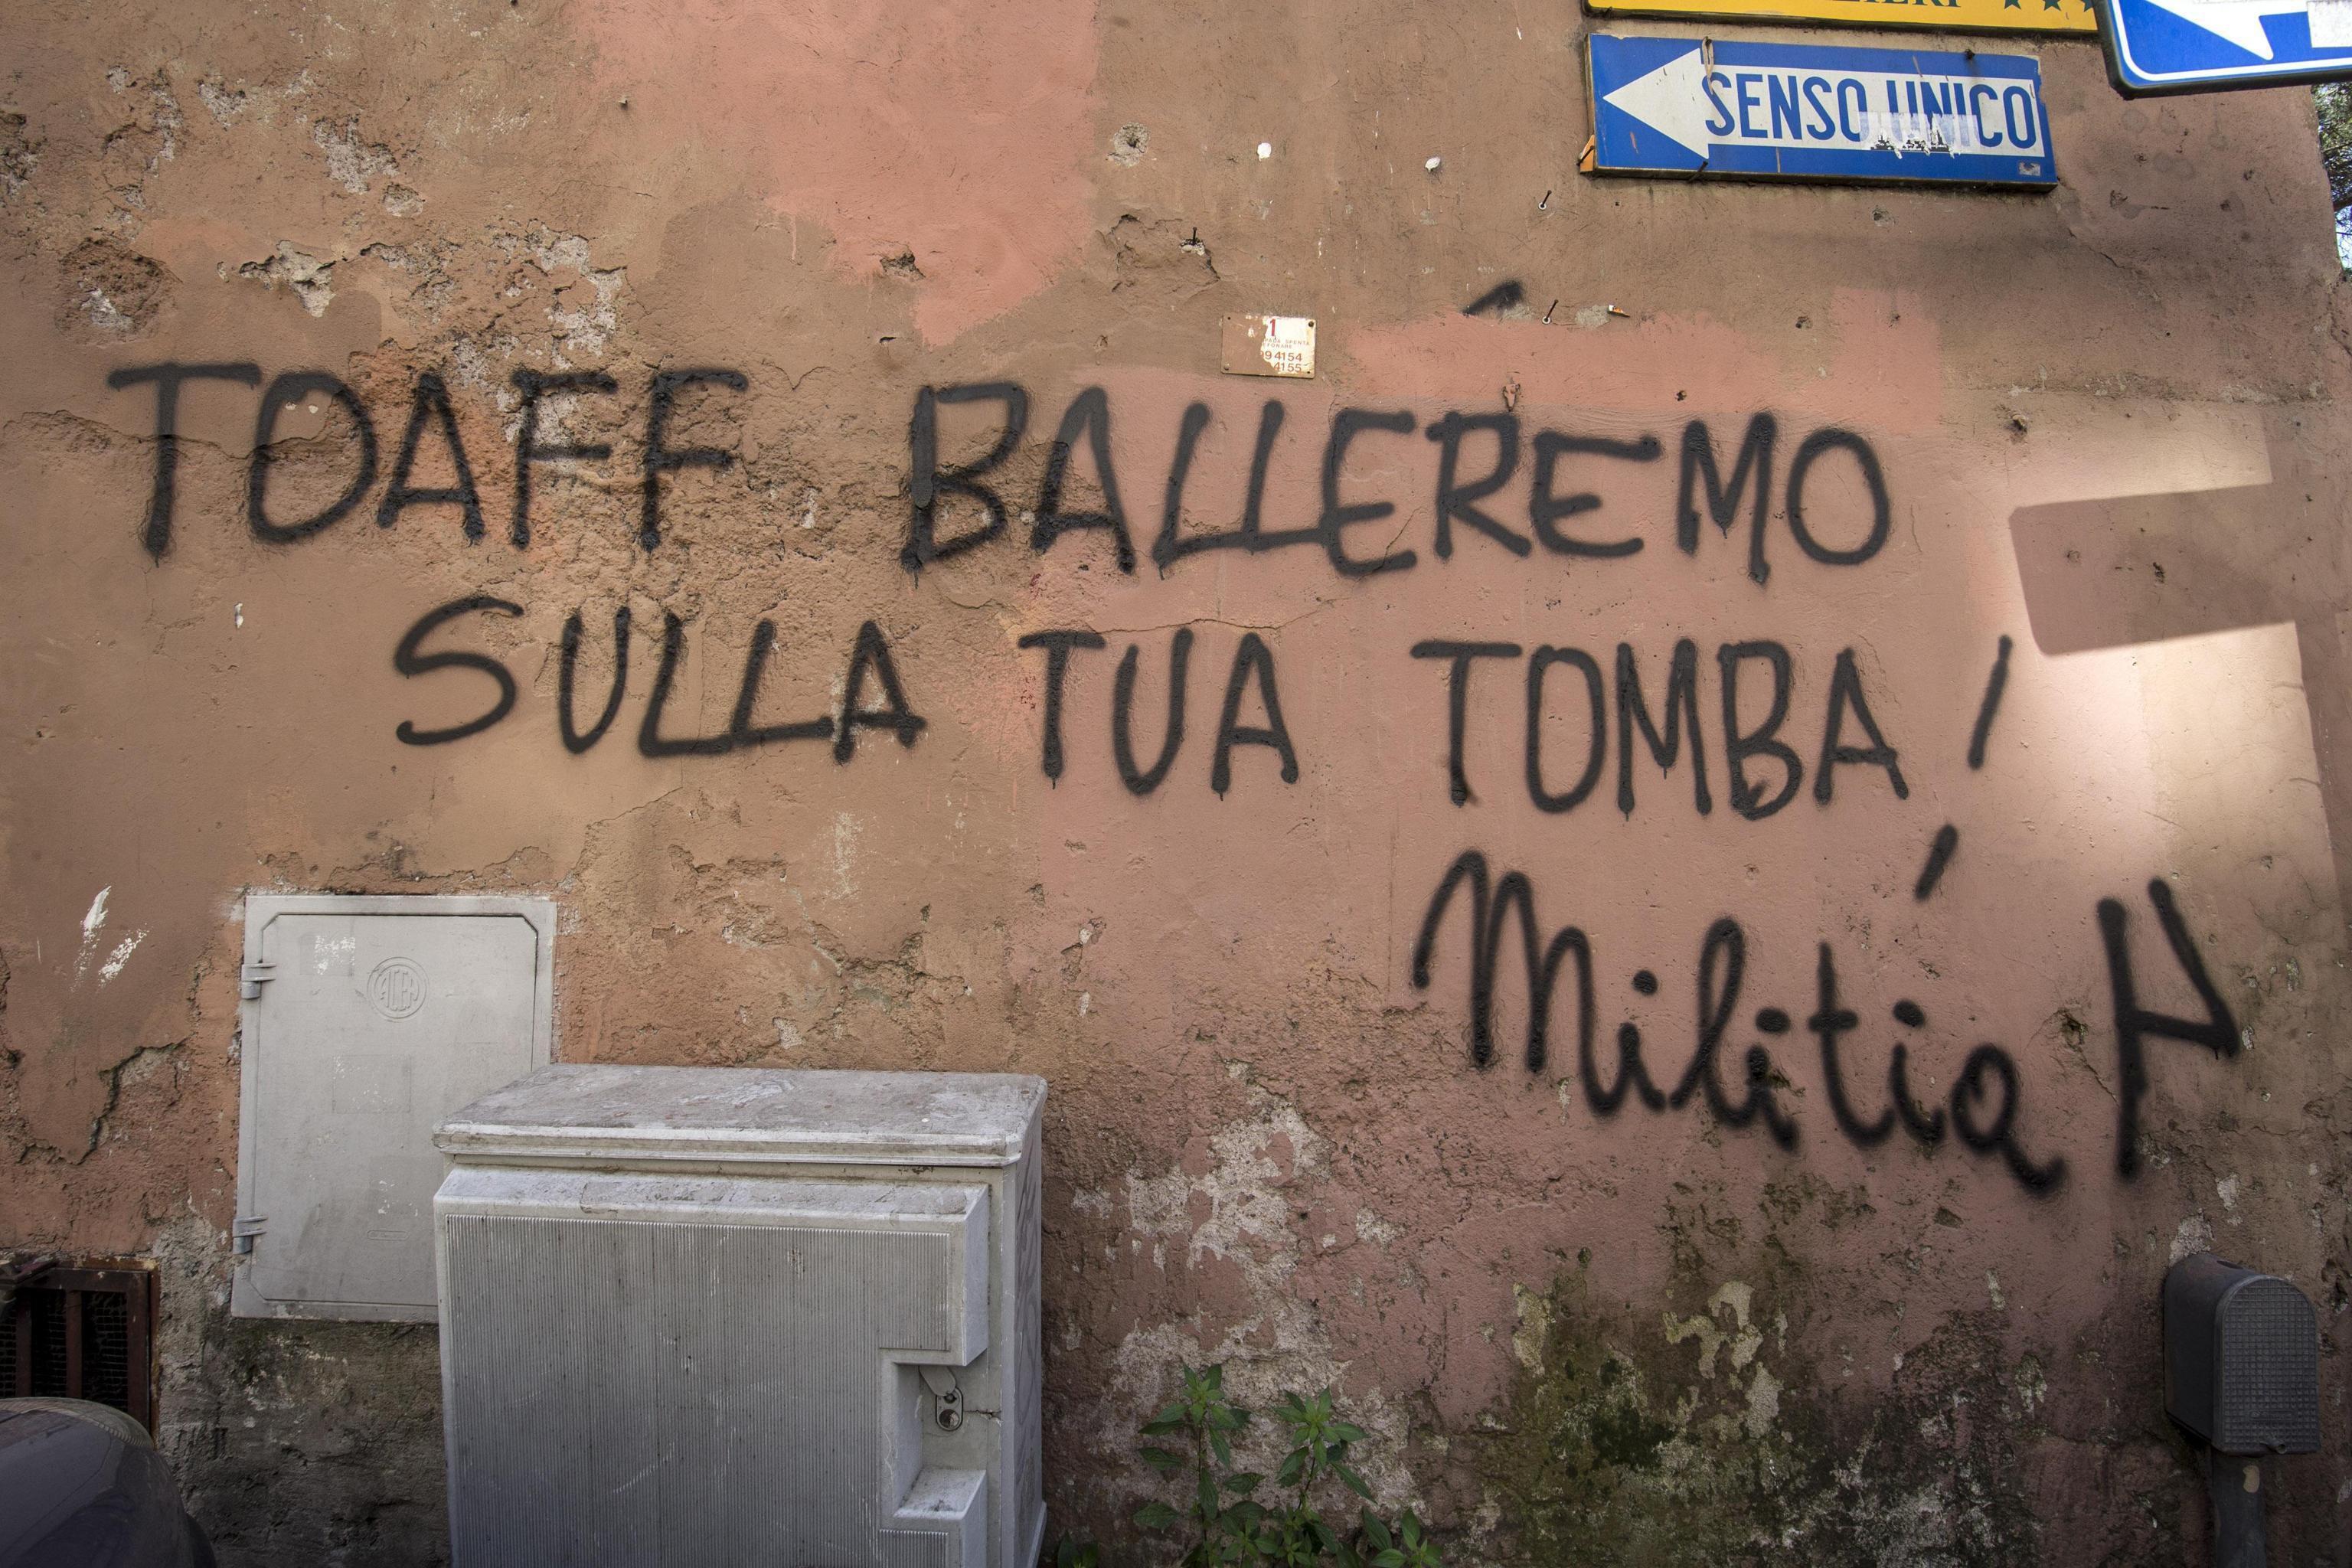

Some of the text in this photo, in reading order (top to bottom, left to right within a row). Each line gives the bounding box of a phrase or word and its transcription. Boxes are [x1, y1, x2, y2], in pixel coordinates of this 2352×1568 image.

[1702, 71, 2037, 149] SENSO UNICO
[106, 363, 1893, 586] TOAFF BALLEREMO
[394, 593, 928, 766] SULLA
[1018, 627, 1299, 796] TUA
